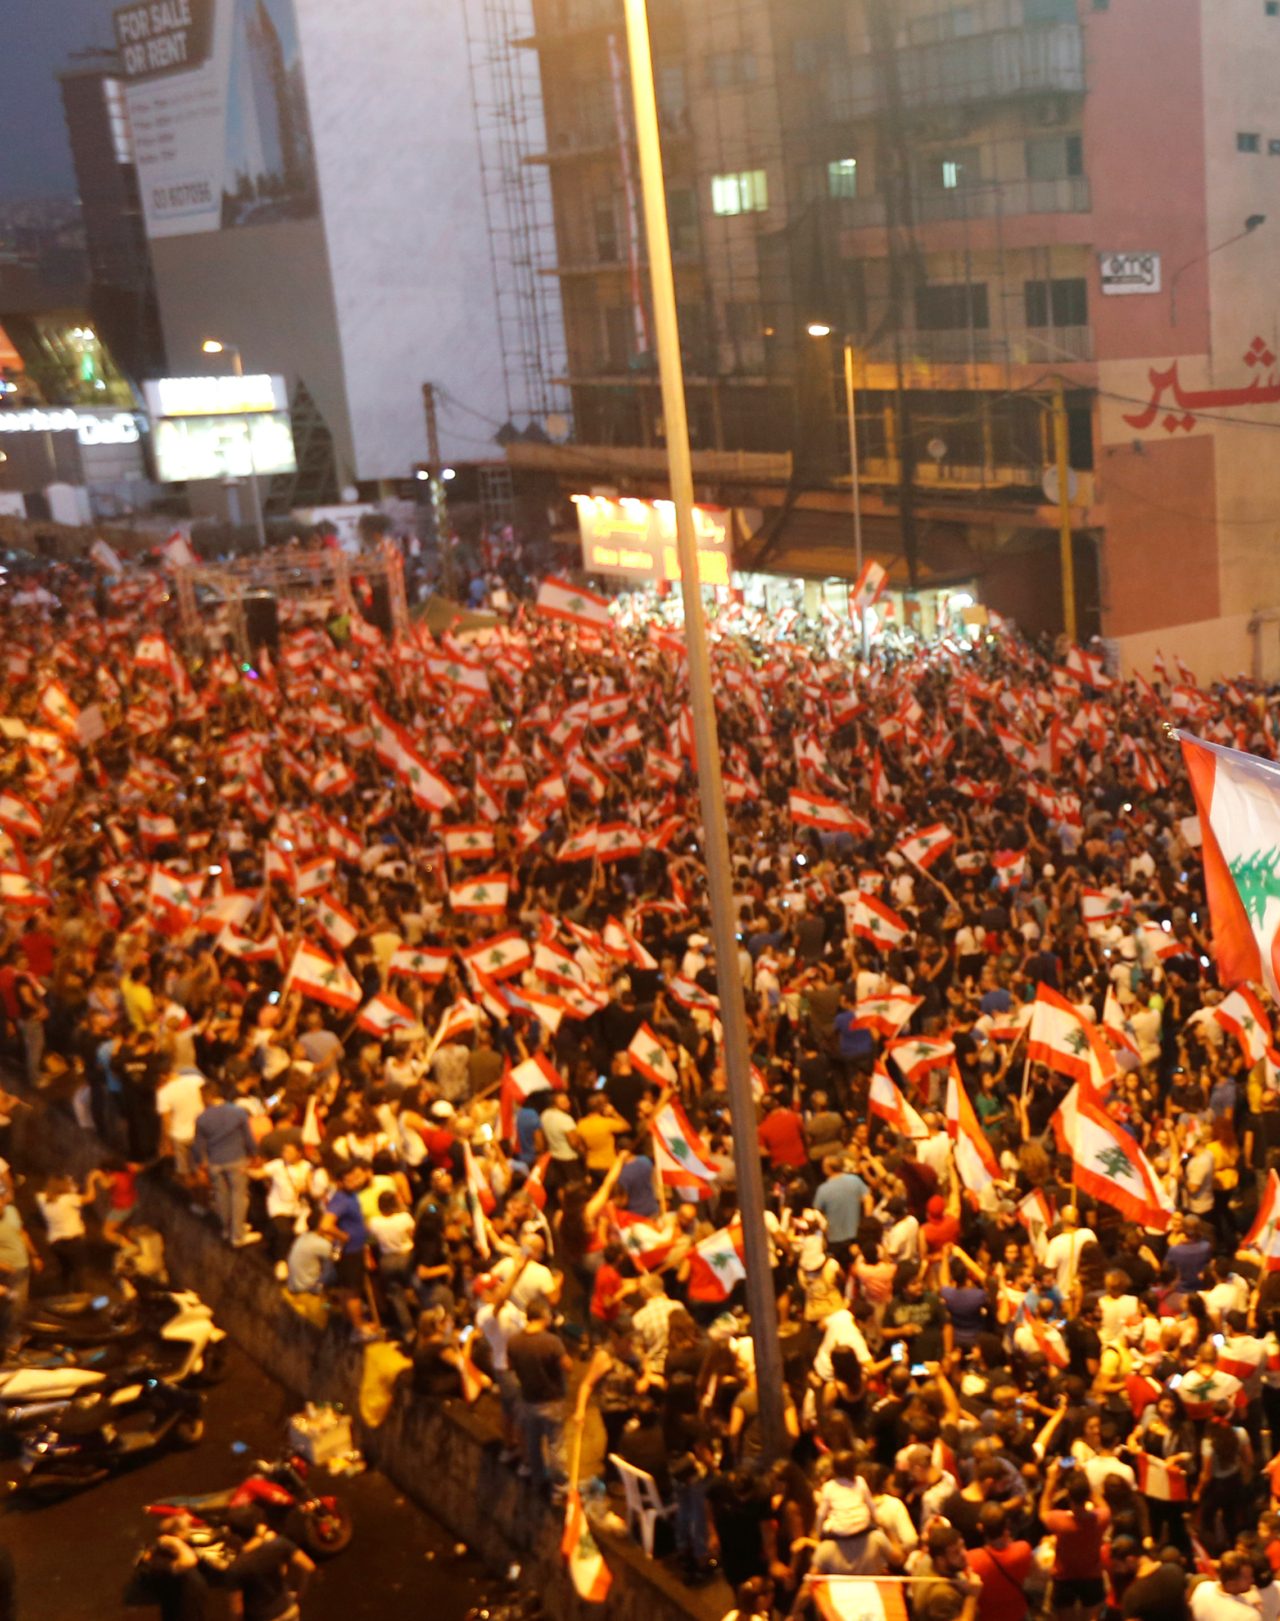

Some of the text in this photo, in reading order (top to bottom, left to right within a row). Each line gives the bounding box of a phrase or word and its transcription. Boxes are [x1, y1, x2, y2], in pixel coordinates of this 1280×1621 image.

[118, 0, 193, 43] FOR SALE
[124, 30, 188, 76] OR RENT
